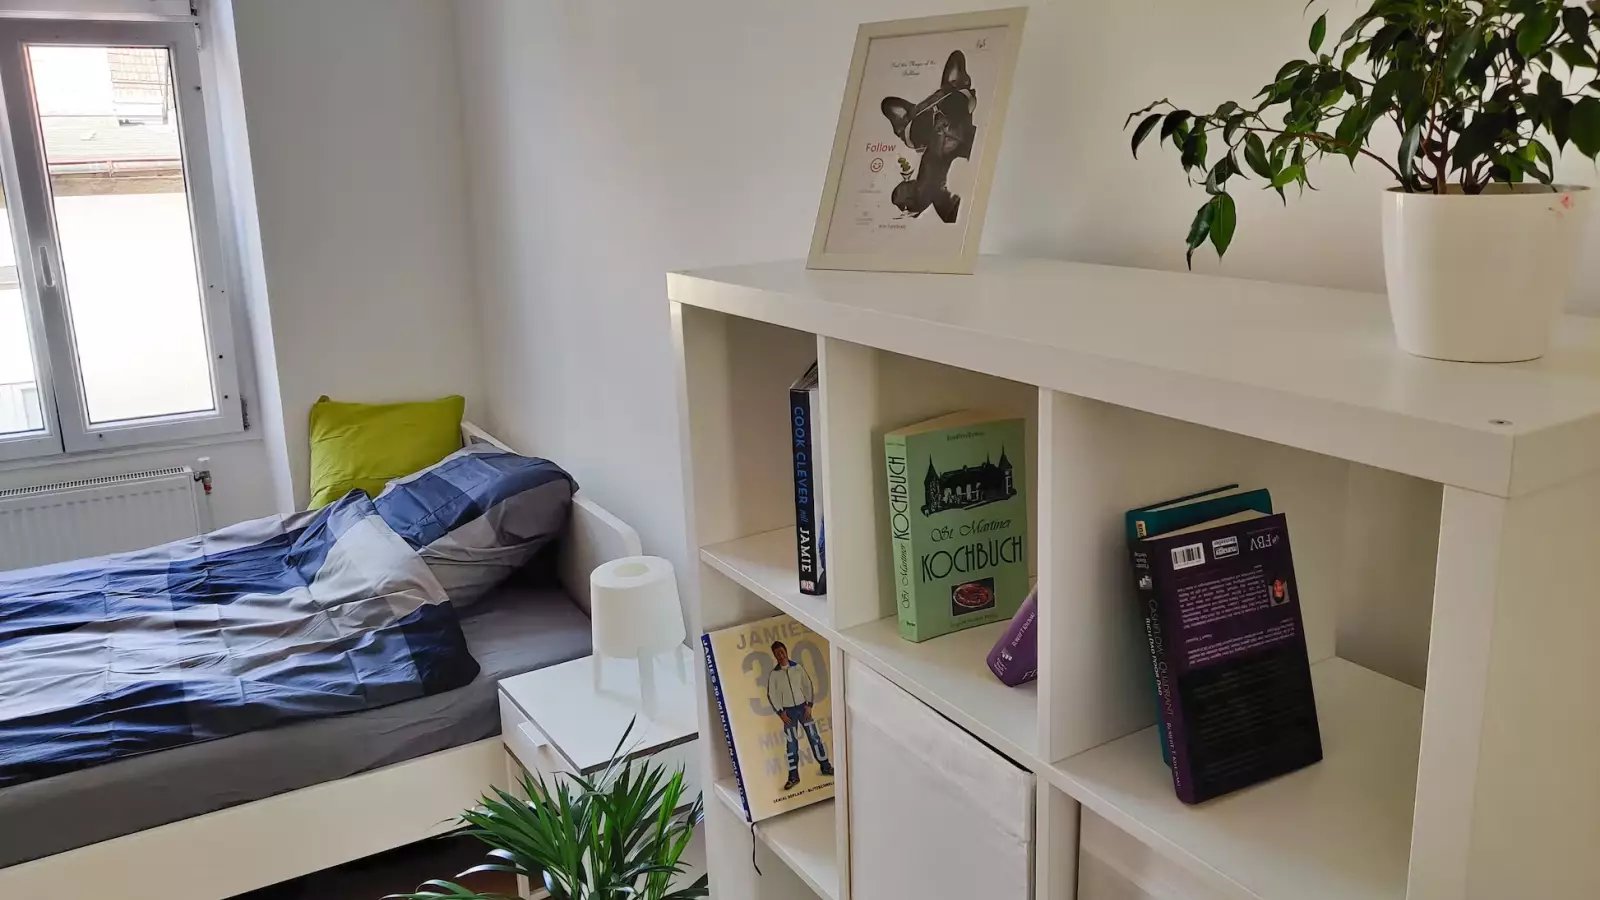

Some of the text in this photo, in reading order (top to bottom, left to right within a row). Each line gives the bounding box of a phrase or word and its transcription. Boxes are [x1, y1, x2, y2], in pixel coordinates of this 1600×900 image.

[866, 141, 896, 153] Follow
[794, 406, 806, 448] COOK
[796, 452, 808, 504] CLEVER
[888, 456, 910, 541] KOCHBUCH
[800, 527, 812, 573] JAMIE
[959, 518, 1012, 536] Martiner
[1250, 534, 1273, 551] FBV
[921, 535, 1023, 583] KOCHBUCH
[702, 637, 716, 683] JAMIES
[742, 639, 829, 717] 30
[1150, 600, 1173, 717] CASHFLOW QUADRANT
